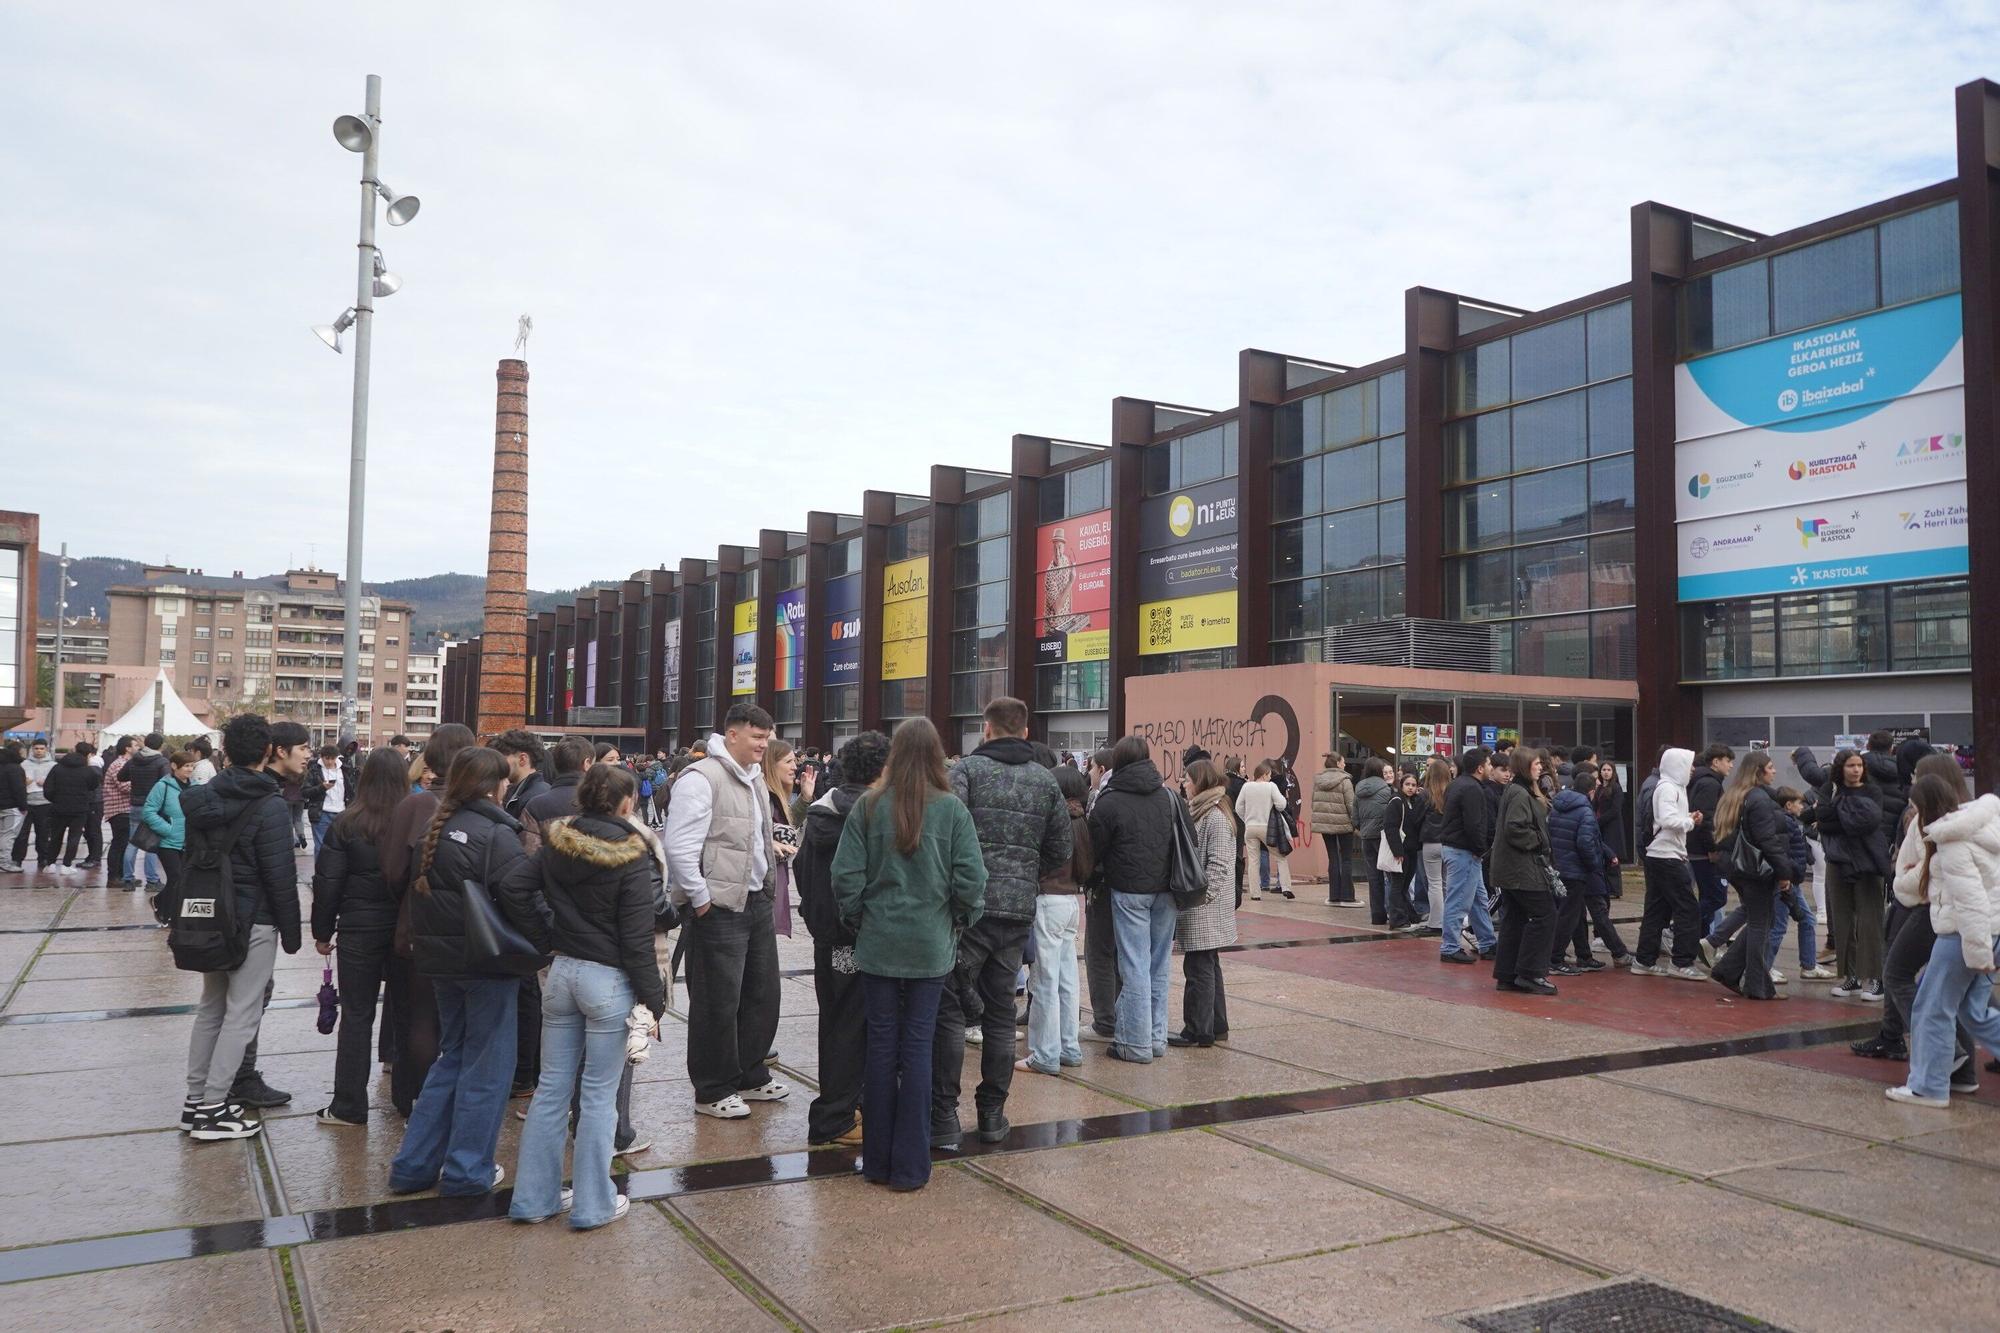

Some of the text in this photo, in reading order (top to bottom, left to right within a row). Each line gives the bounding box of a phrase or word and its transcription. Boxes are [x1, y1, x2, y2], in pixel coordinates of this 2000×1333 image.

[1793, 328, 1857, 352] IKASTOLAK
[1791, 340, 1860, 364] ELKARREKIN
[1788, 352, 1863, 377] GEROA HEZIZ
[1802, 378, 1864, 403] ibaizabal
[1809, 453, 1858, 467] KURUTZIAGA
[1809, 462, 1856, 477] IKASTOLA
[1216, 497, 1235, 509] PUNTU
[1924, 508, 1945, 518] Zubi
[1924, 519, 1947, 528] Herri
[1821, 527, 1855, 537] ELORRIOKO
[1821, 534, 1851, 543] IKASTOLA
[1713, 535, 1754, 547] ANDRAMARI
[1812, 565, 1869, 581] IKASTOLAK
[1041, 641, 1062, 651] EUSEBIO
[1192, 717, 1266, 748] MATXISTA
[187, 901, 212, 914] VANS
